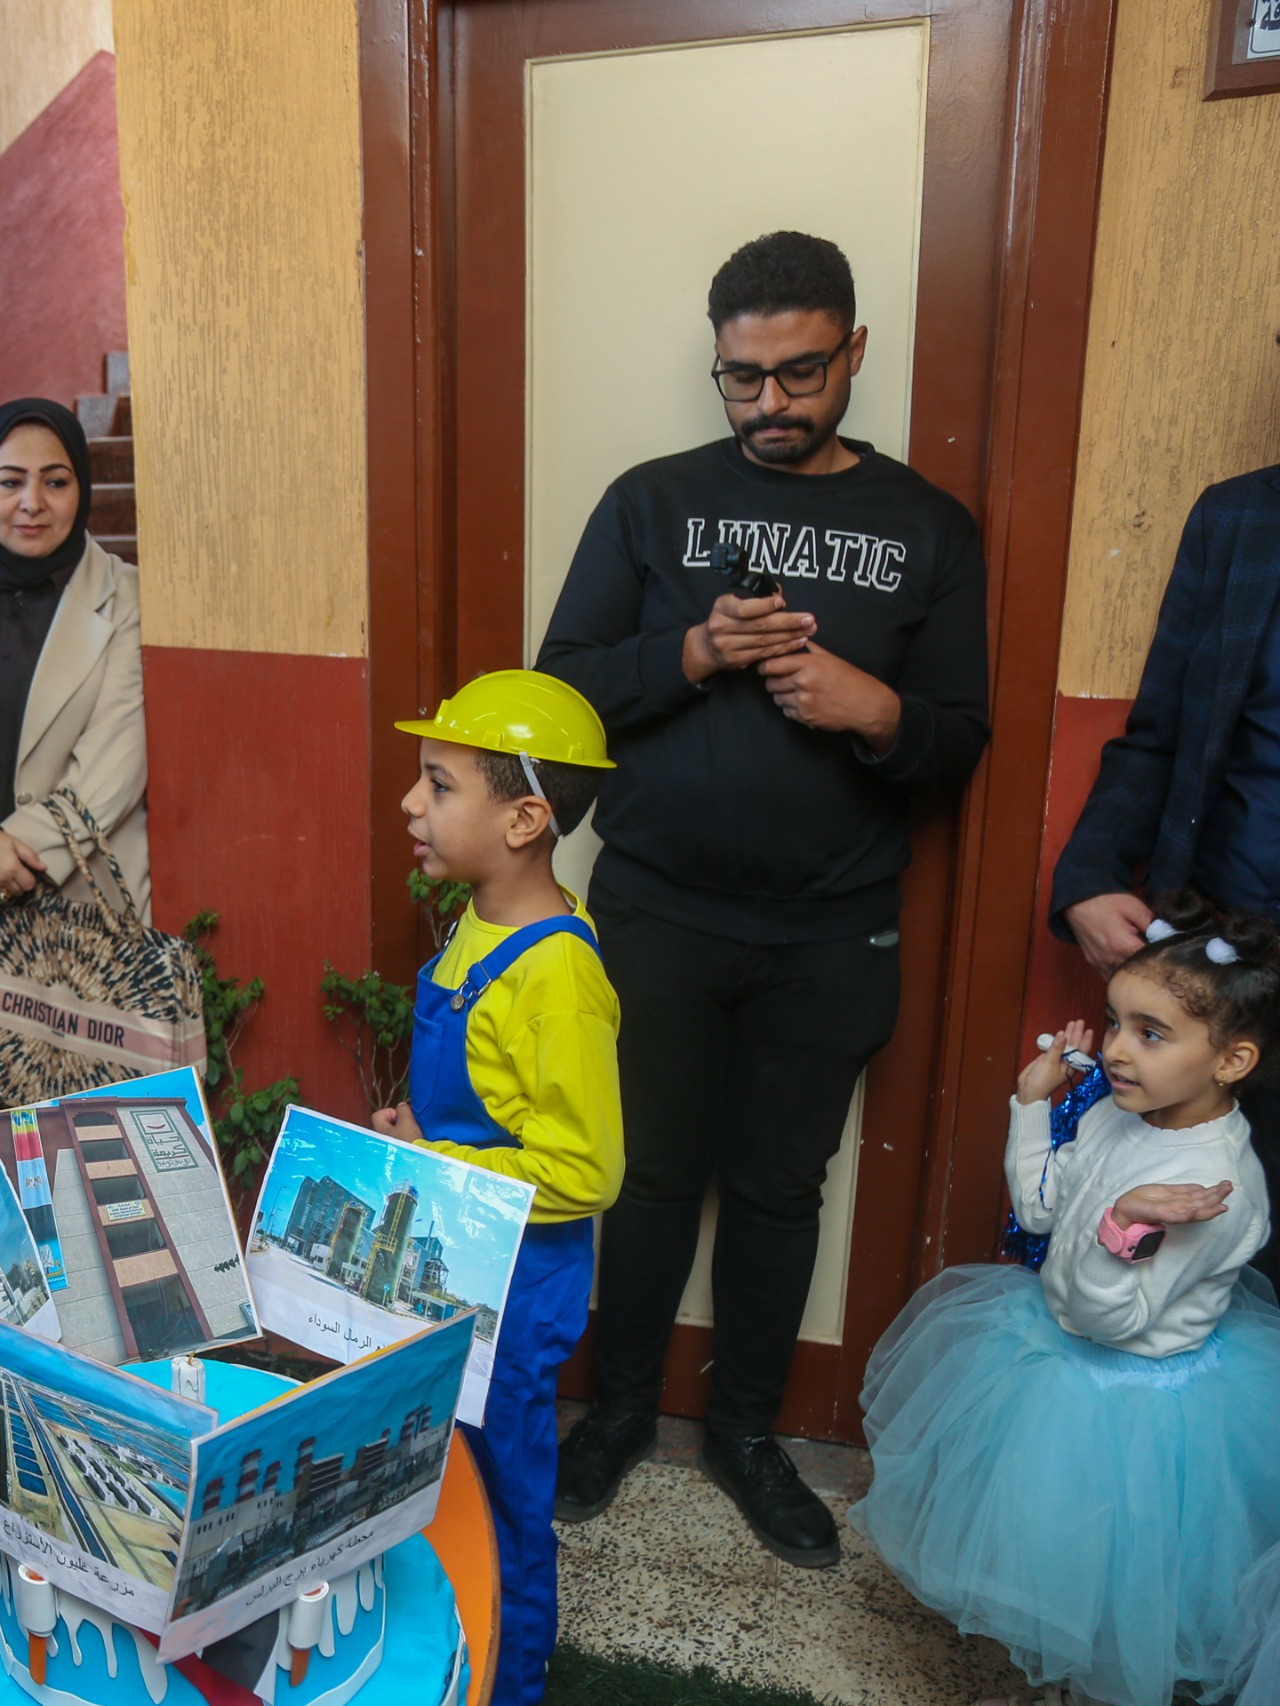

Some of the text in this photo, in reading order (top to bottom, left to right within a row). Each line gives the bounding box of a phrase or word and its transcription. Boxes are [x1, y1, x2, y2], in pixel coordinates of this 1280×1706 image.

[682, 517, 907, 593] LUNATIC
[1, 991, 125, 1047] CHRISTIAN DIOR
[308, 1314, 340, 1334] السوداء
[346, 1531, 374, 1548] محطة
[56, 1552, 89, 1573] غليون
[94, 1565, 135, 1597] مزرعة
